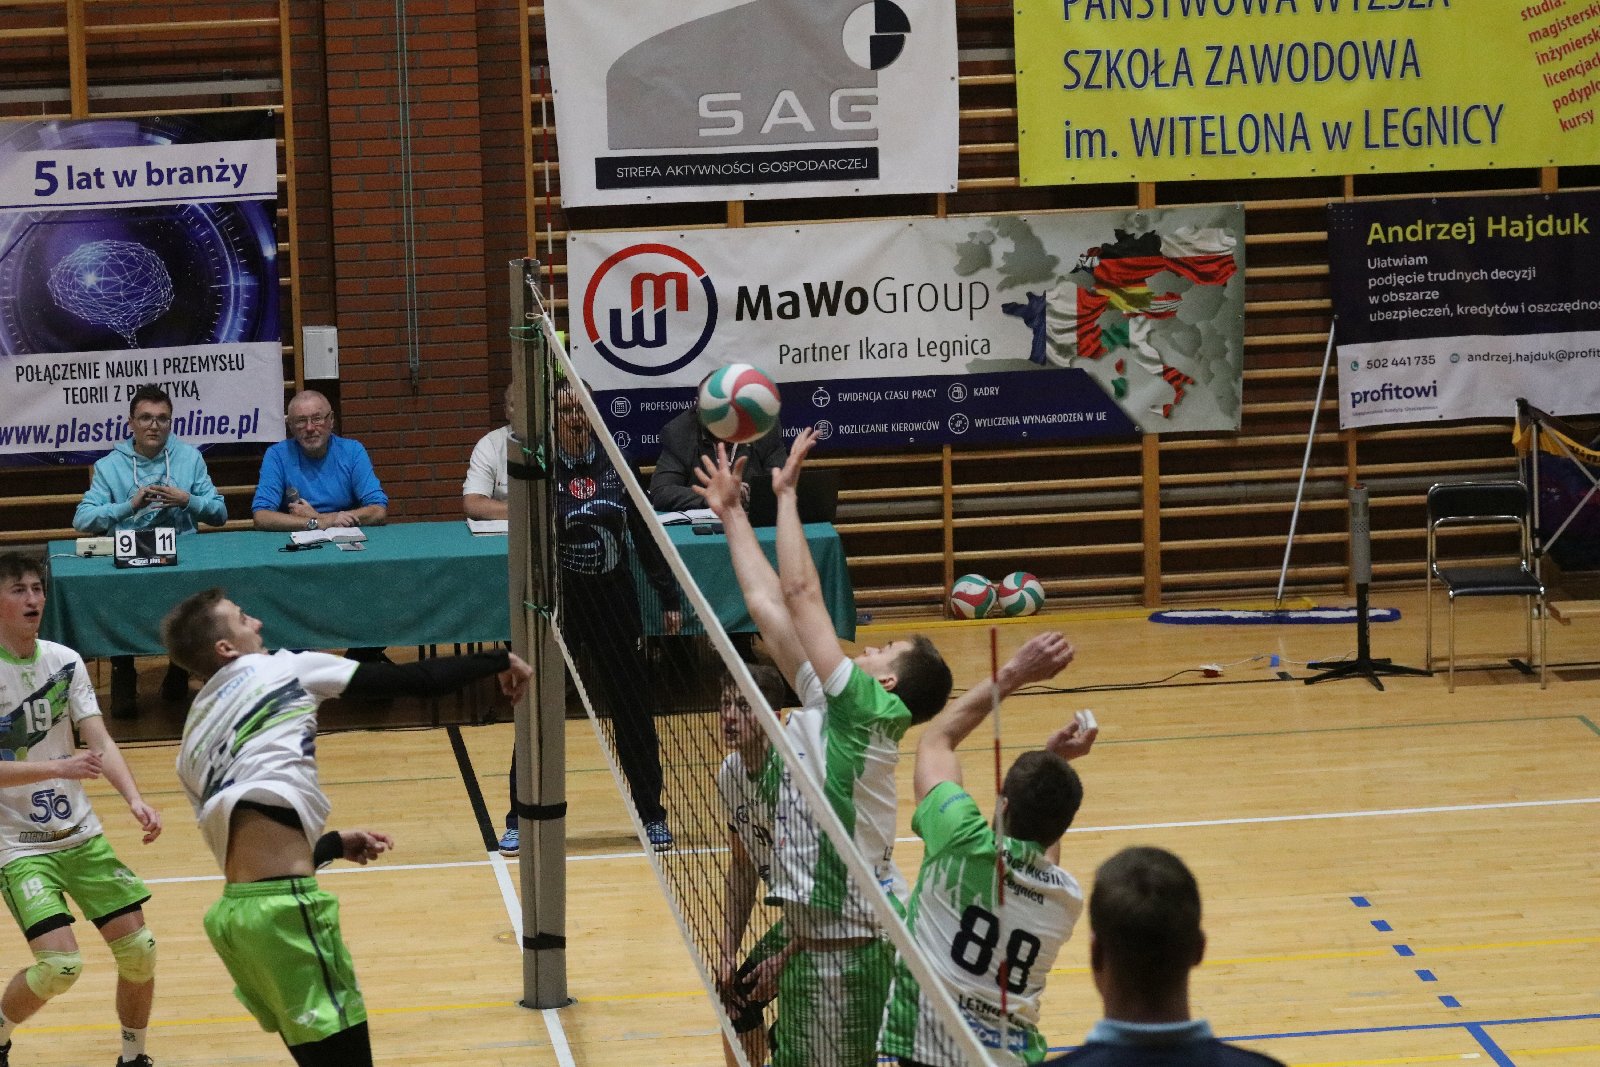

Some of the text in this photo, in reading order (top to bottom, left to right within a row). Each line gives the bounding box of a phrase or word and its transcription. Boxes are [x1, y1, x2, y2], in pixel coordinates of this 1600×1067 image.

[1535, 25, 1600, 66] inżyniersk
[1063, 38, 1422, 90] SZKOŁA ZAWODOWA
[1543, 52, 1600, 88] licencjac
[698, 87, 878, 137] SAG
[1559, 109, 1594, 133] kursy
[1063, 104, 1505, 160] im. WITELONA w LEGNICY
[34, 157, 249, 197] 5 lat w branży
[616, 158, 869, 179] STREFA AKTYWNOŚCI GOSPODARCZEJ
[1366, 212, 1590, 246] Andrzej Hajduk
[1367, 254, 1428, 270] Ułatwiam
[1368, 266, 1537, 289] podjęcie trudnych decyzji
[735, 276, 990, 321] MaWoGroup
[1368, 288, 1440, 304] w obszarze
[1369, 303, 1454, 322] ubezpieczeń,
[1456, 302, 1519, 318] kredytów
[1520, 302, 1525, 313] i
[779, 334, 991, 365] Partner Ikara Legnica
[15, 353, 245, 384] POŁĄCZENIE NAUKI I PRZEMYSŁU
[1366, 355, 1436, 370] 502 441 735
[63, 380, 201, 404] TEORII Z PRKTYKĄ
[837, 388, 937, 403] EWIDENCJA CZASU PRACY
[973, 386, 1000, 397] KADRY
[1350, 380, 1438, 408] profitowi
[838, 419, 940, 435] ROZLICZANIE KIEROWCÓW
[974, 411, 1107, 428] WYLICZENIA WYNAGRODZEŃ W UE
[119, 535, 133, 553] 9
[158, 533, 173, 551] 11
[22, 699, 52, 734] 19
[951, 905, 1041, 994] 88
